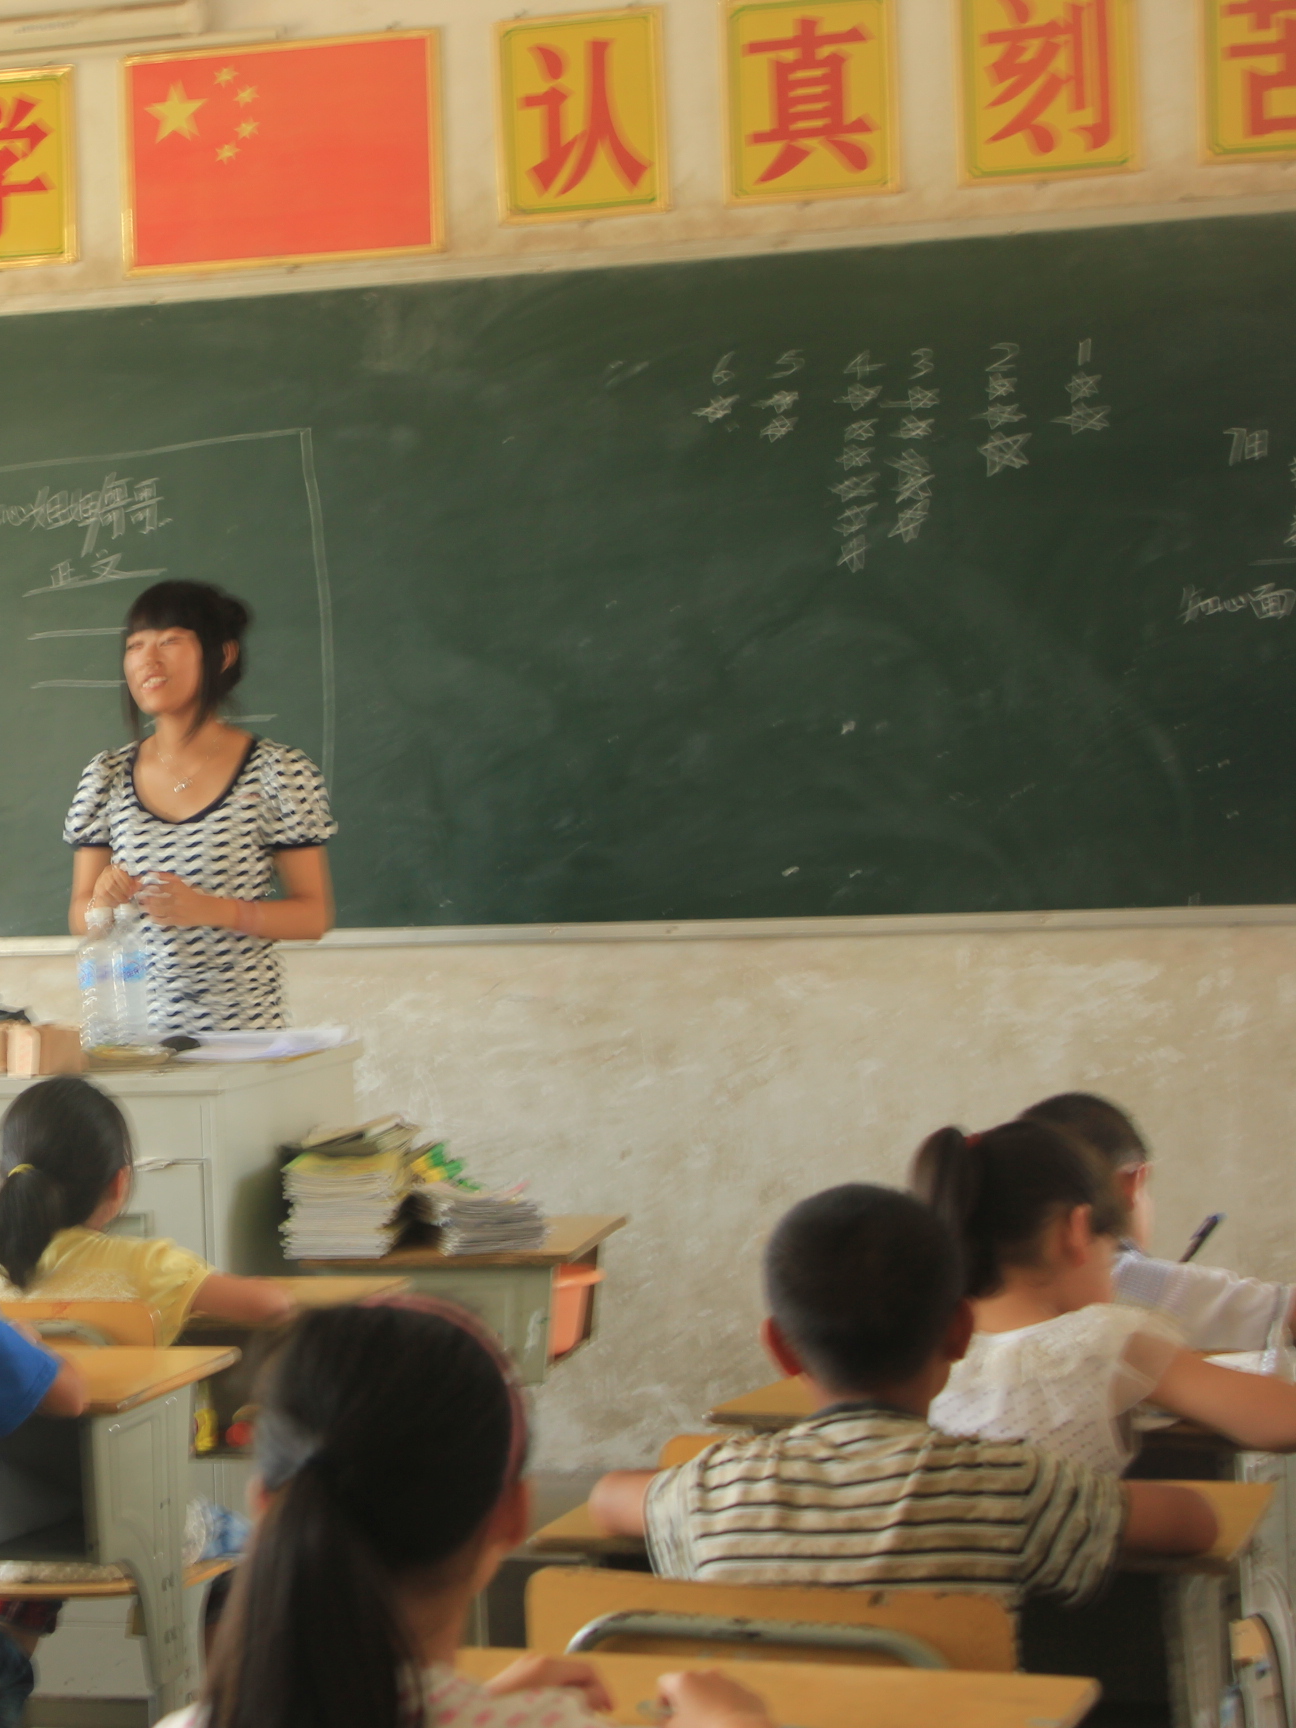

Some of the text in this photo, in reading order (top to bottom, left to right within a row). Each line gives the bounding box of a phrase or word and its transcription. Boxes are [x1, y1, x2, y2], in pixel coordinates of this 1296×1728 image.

[712, 338, 1093, 386] 6 5 4 3 2 1
[50, 549, 123, 589] 正文
